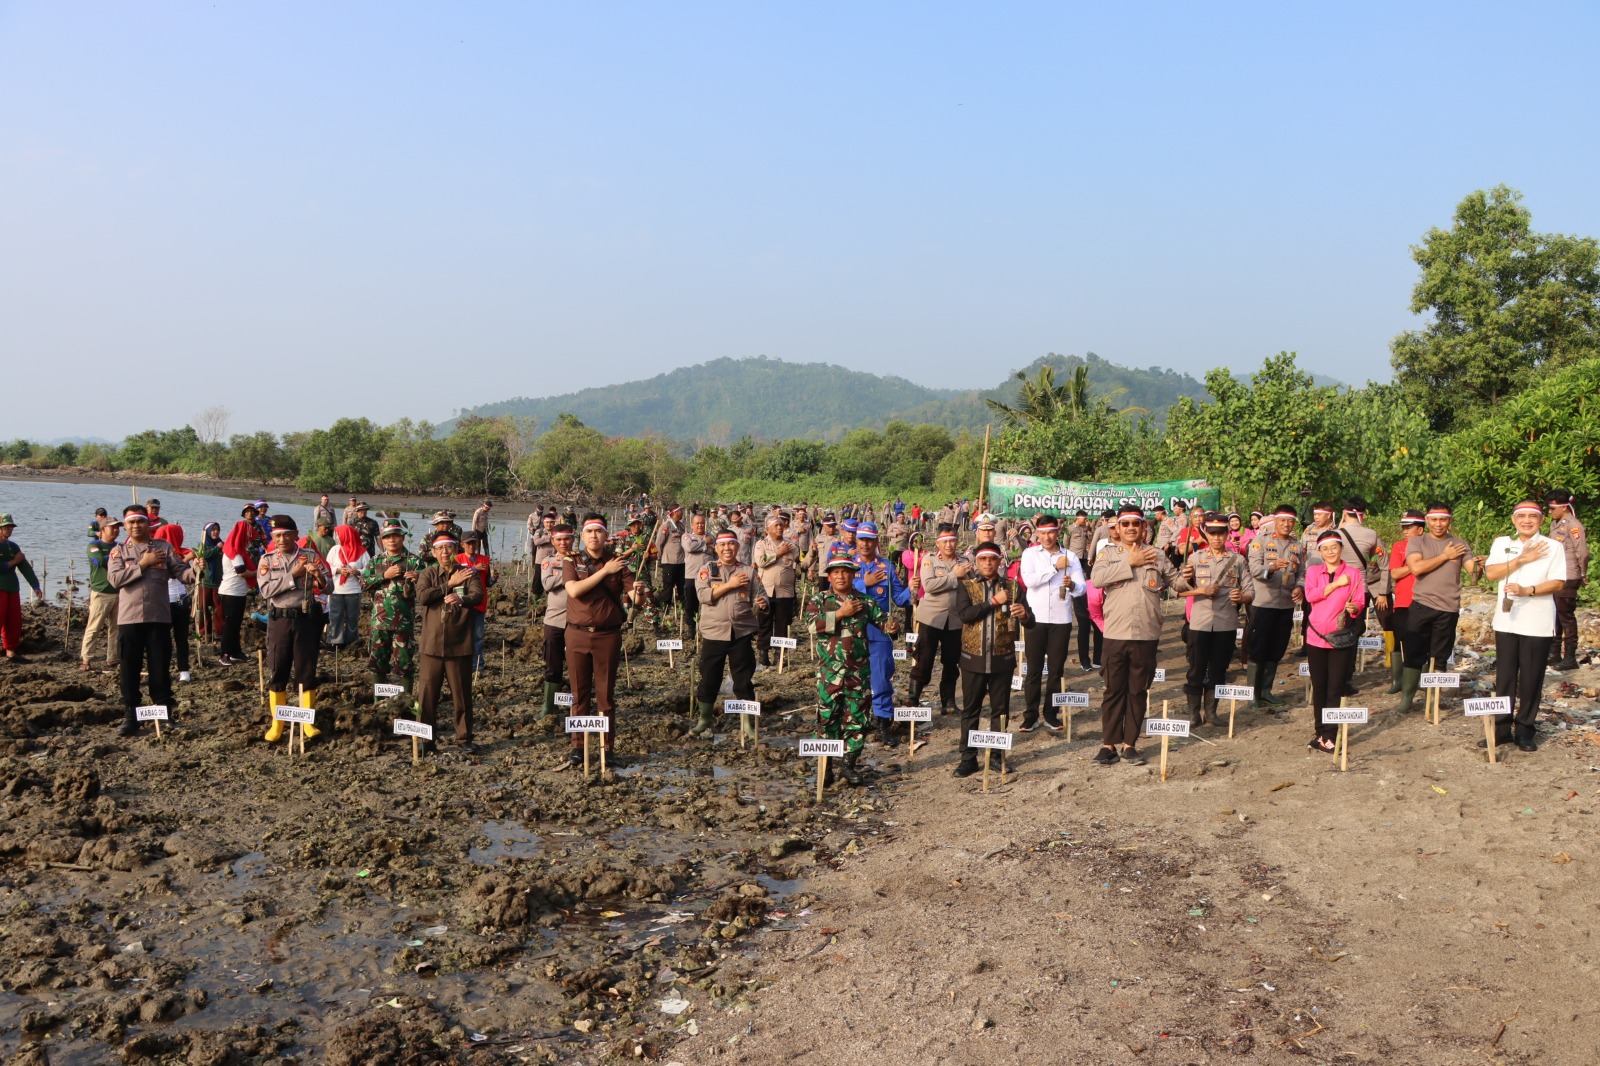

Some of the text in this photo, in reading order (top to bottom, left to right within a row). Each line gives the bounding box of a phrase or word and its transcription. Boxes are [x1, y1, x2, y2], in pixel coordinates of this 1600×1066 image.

[1079, 485, 1125, 498] Lestarikan
[1127, 487, 1161, 498] Negeri
[1014, 493, 1114, 511] PENGHIJAUAN
[1424, 676, 1436, 684] KASAT
[1218, 687, 1251, 697] KASAT BINMAS
[557, 695, 569, 703] KASI
[1055, 695, 1067, 703] KASAT
[728, 703, 758, 712] KABAG REN
[1468, 700, 1505, 711] WALIKOTA
[140, 709, 158, 718] KABAG
[278, 709, 292, 718] KASAT
[897, 710, 928, 718] KASAT POLAIR
[569, 719, 604, 729] KAJARI
[1149, 722, 1186, 733] KABAG SDM
[972, 734, 1007, 746] KETUA DPRD KOTA
[803, 743, 839, 753] DANDIM
